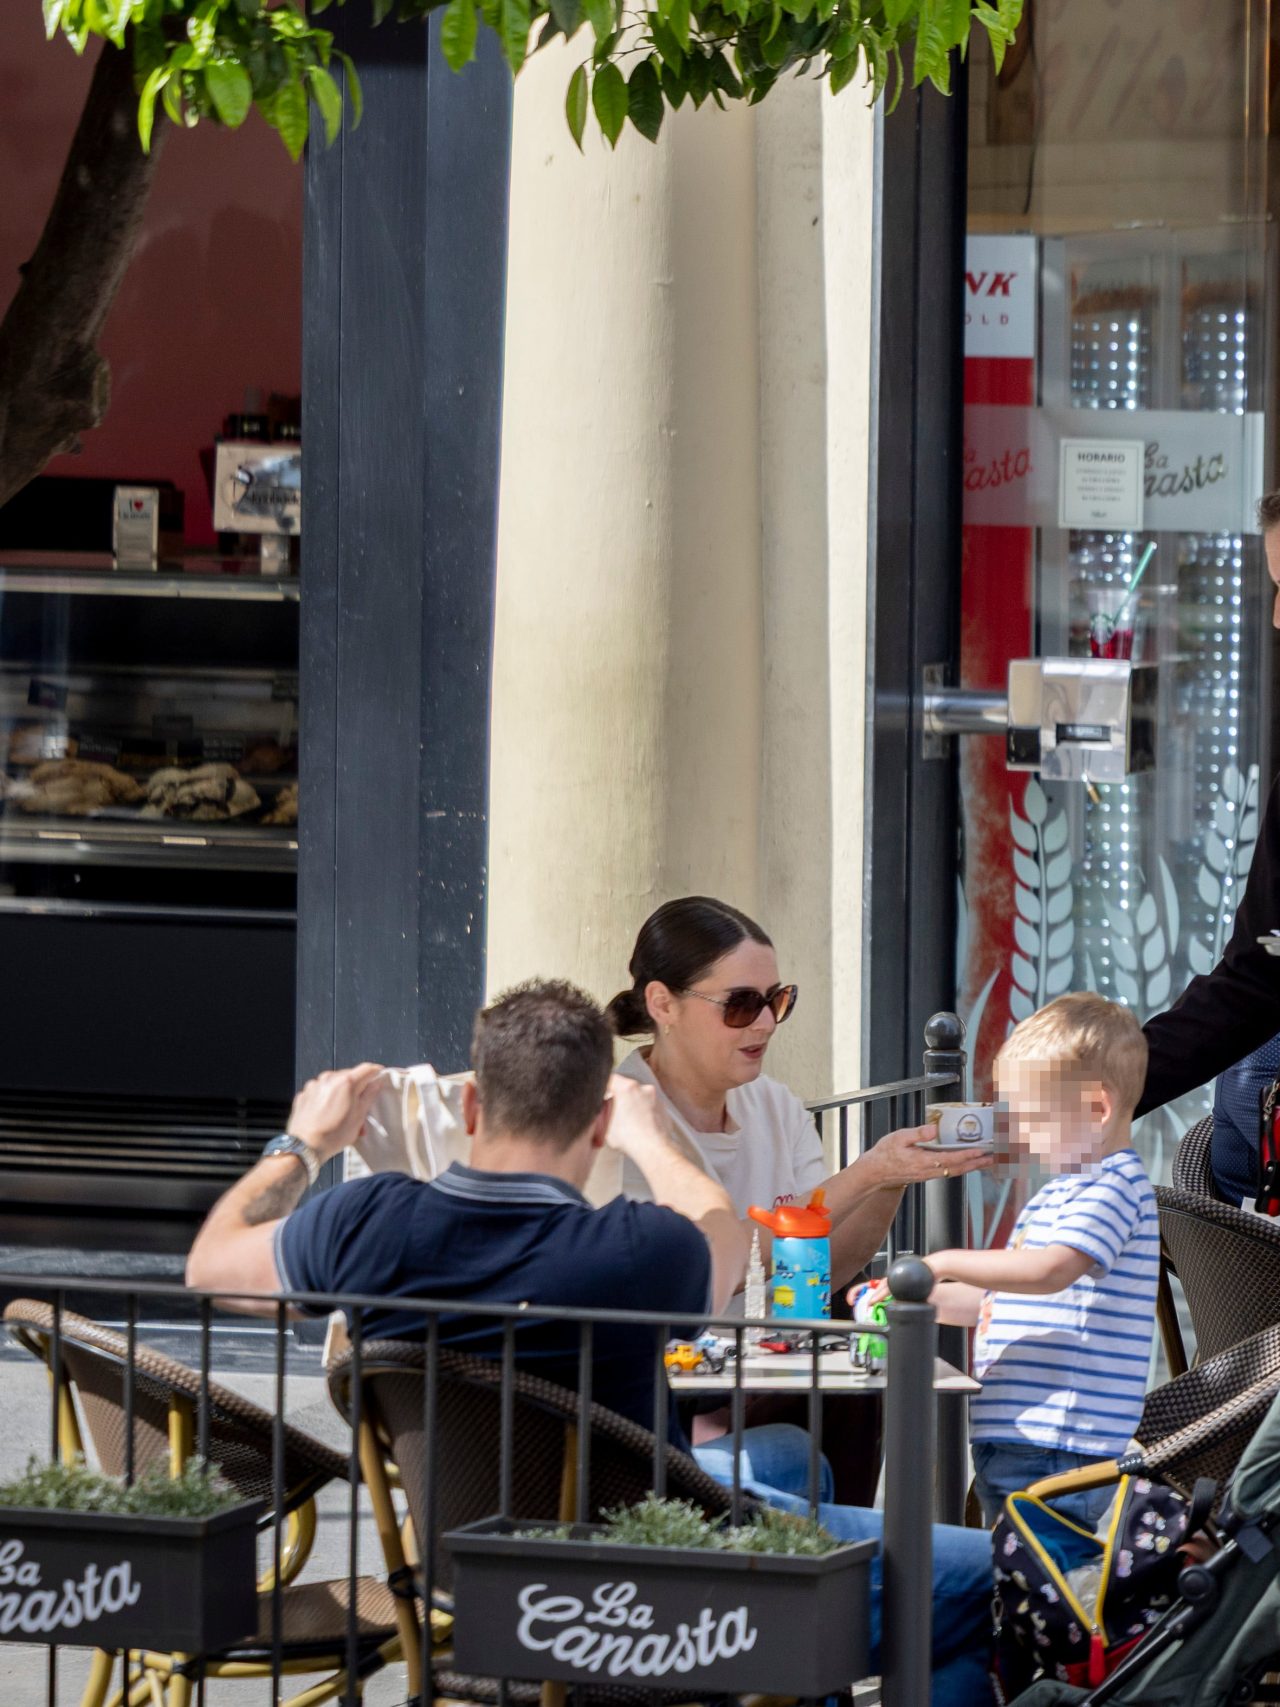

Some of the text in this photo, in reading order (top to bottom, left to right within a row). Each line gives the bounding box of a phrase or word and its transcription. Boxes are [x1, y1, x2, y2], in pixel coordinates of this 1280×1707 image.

[1077, 452, 1126, 463] HORARIO
[517, 1583, 758, 1677] Canasta
[584, 1581, 655, 1630] La
